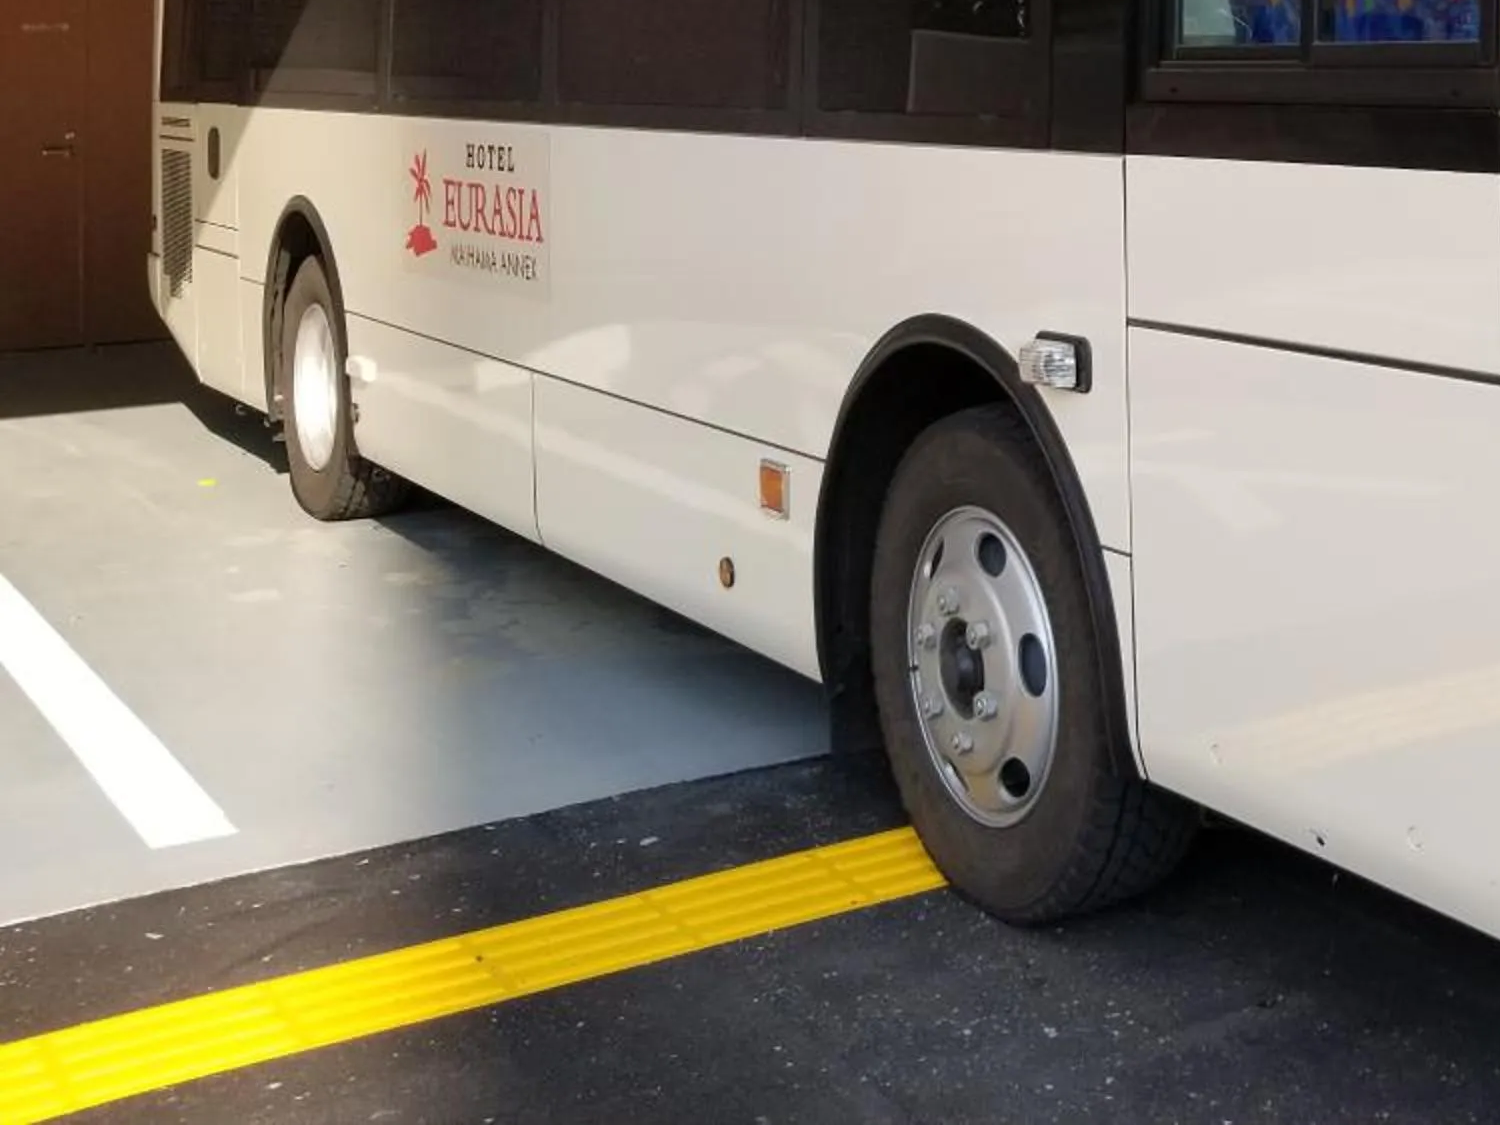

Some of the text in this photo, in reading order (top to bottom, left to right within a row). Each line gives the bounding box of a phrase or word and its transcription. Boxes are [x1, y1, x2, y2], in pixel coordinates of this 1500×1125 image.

[465, 143, 515, 172] HOTEL
[442, 178, 544, 243] EURASIA
[500, 250, 538, 280] ANNEX
